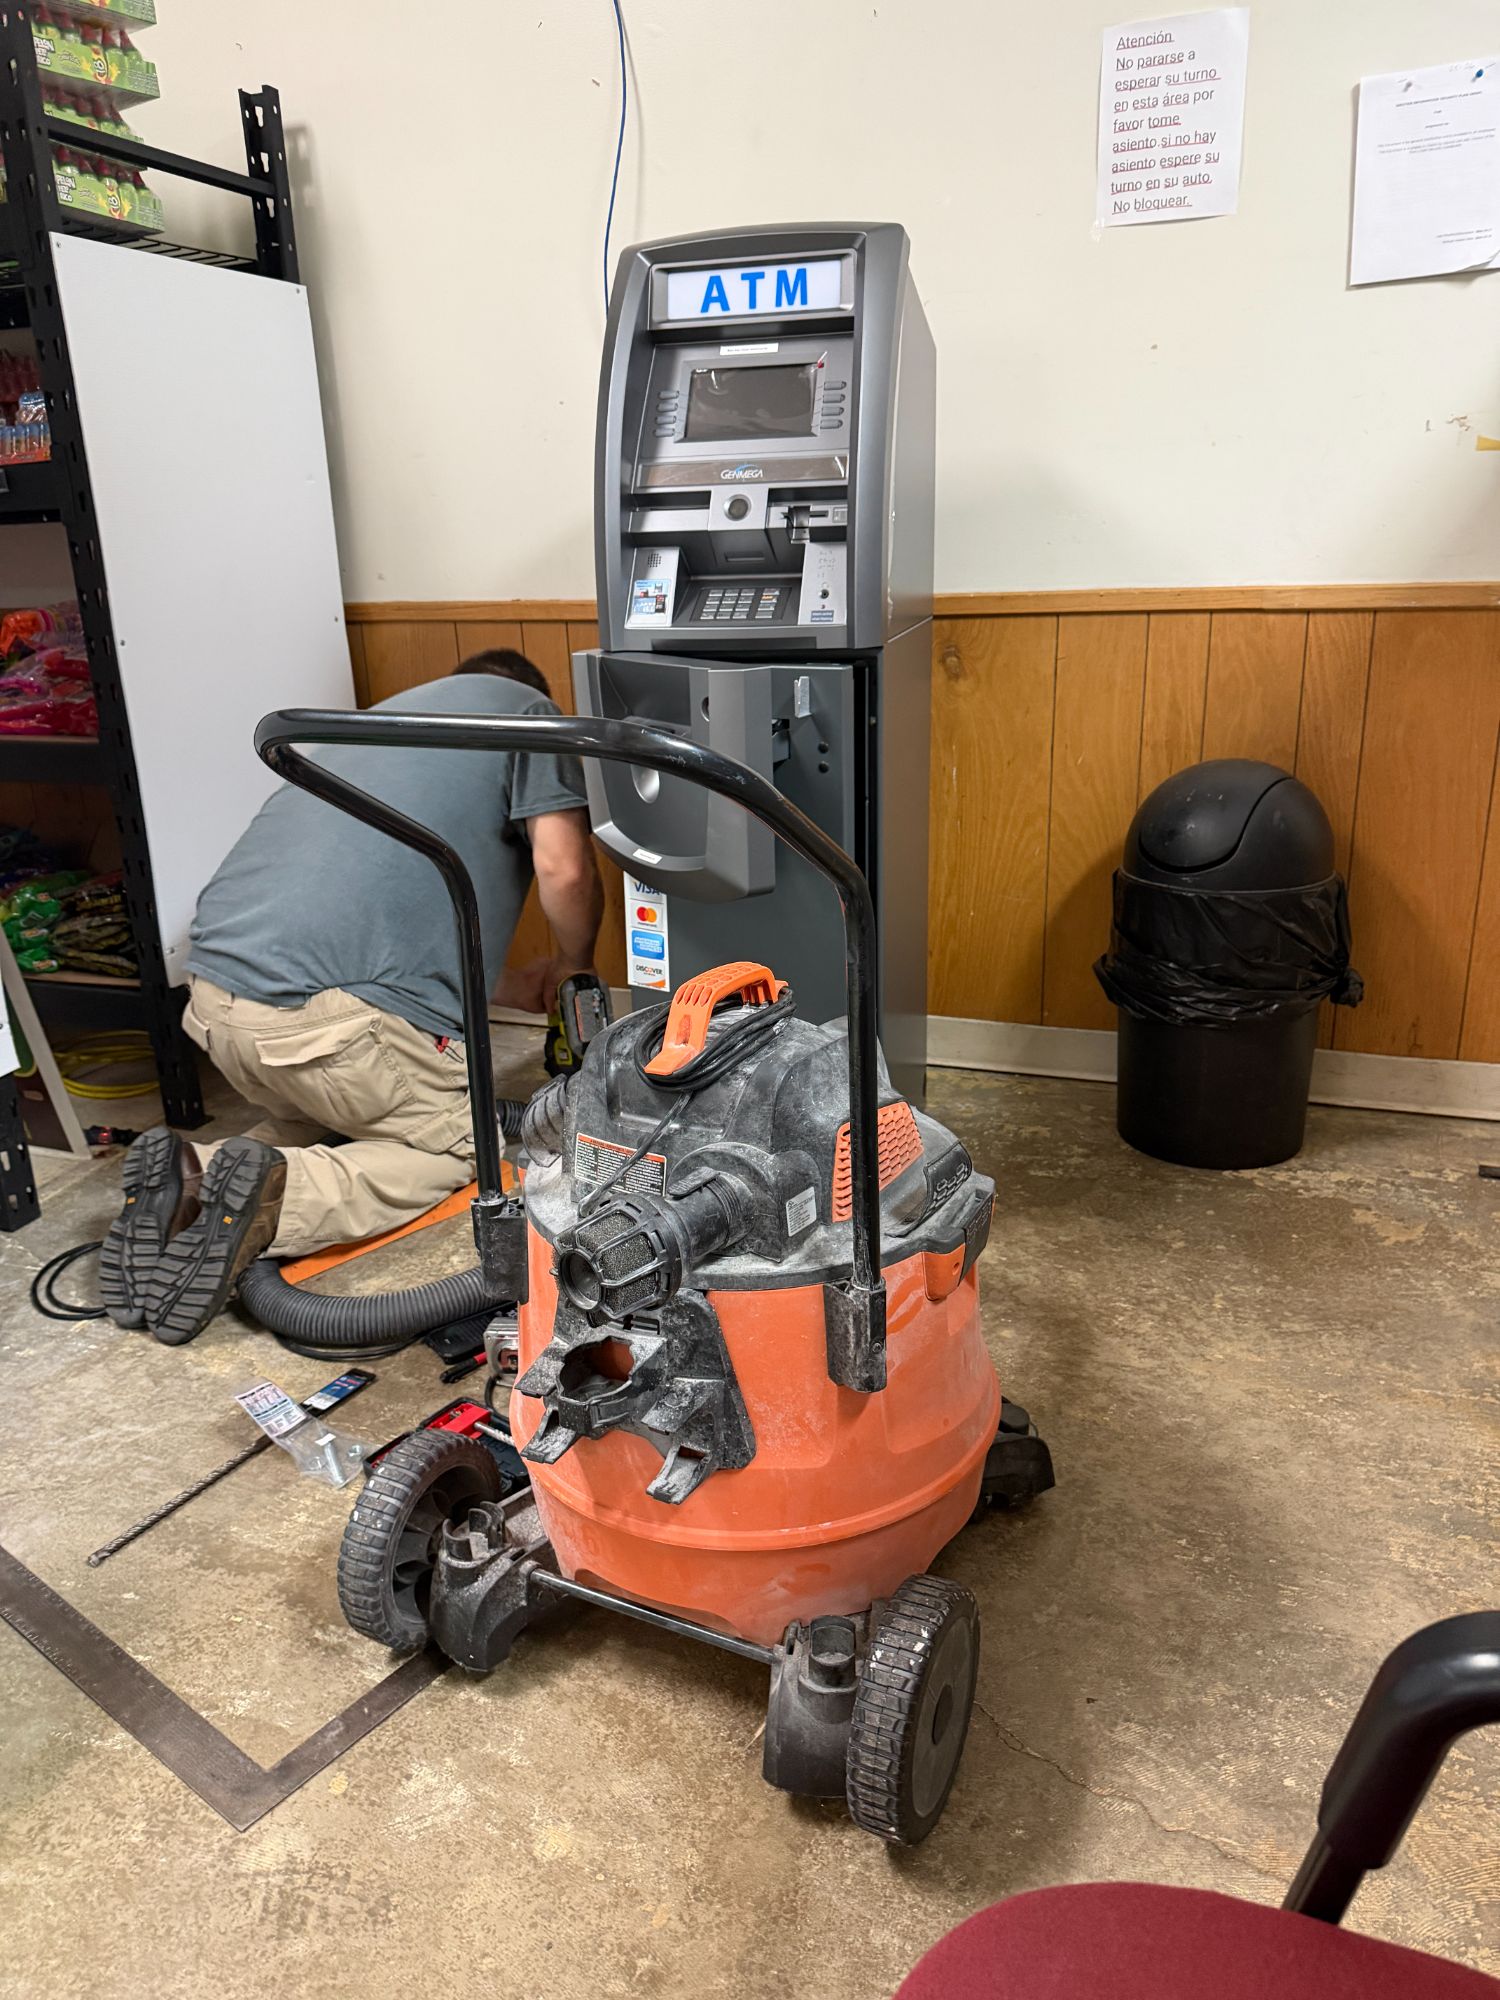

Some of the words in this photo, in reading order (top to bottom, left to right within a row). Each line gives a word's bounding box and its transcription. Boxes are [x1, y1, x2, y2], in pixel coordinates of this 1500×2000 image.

[1116, 57, 1133, 71] No
[1137, 51, 1184, 70] pararse
[1188, 50, 1196, 60] a
[1115, 75, 1161, 92] esperar
[1165, 73, 1179, 85] su
[1184, 68, 1217, 81] turno
[1114, 100, 1128, 112] en
[1133, 96, 1158, 109] esta
[1163, 92, 1189, 106] área
[1193, 89, 1215, 105] por
[1113, 119, 1144, 132] favor
[1175, 134, 1190, 145] no
[1194, 130, 1217, 144] hay
[1112, 157, 1156, 173] asiento
[1160, 153, 1201, 168] espere
[1205, 151, 1220, 163] su
[1111, 180, 1142, 194] turno
[1146, 178, 1160, 190] en
[1164, 176, 1178, 188] su
[1113, 201, 1130, 213] No
[700, 267, 809, 313] ATM
[720, 469, 763, 479] GENMEGA
[636, 964, 663, 975] DISCOVER
